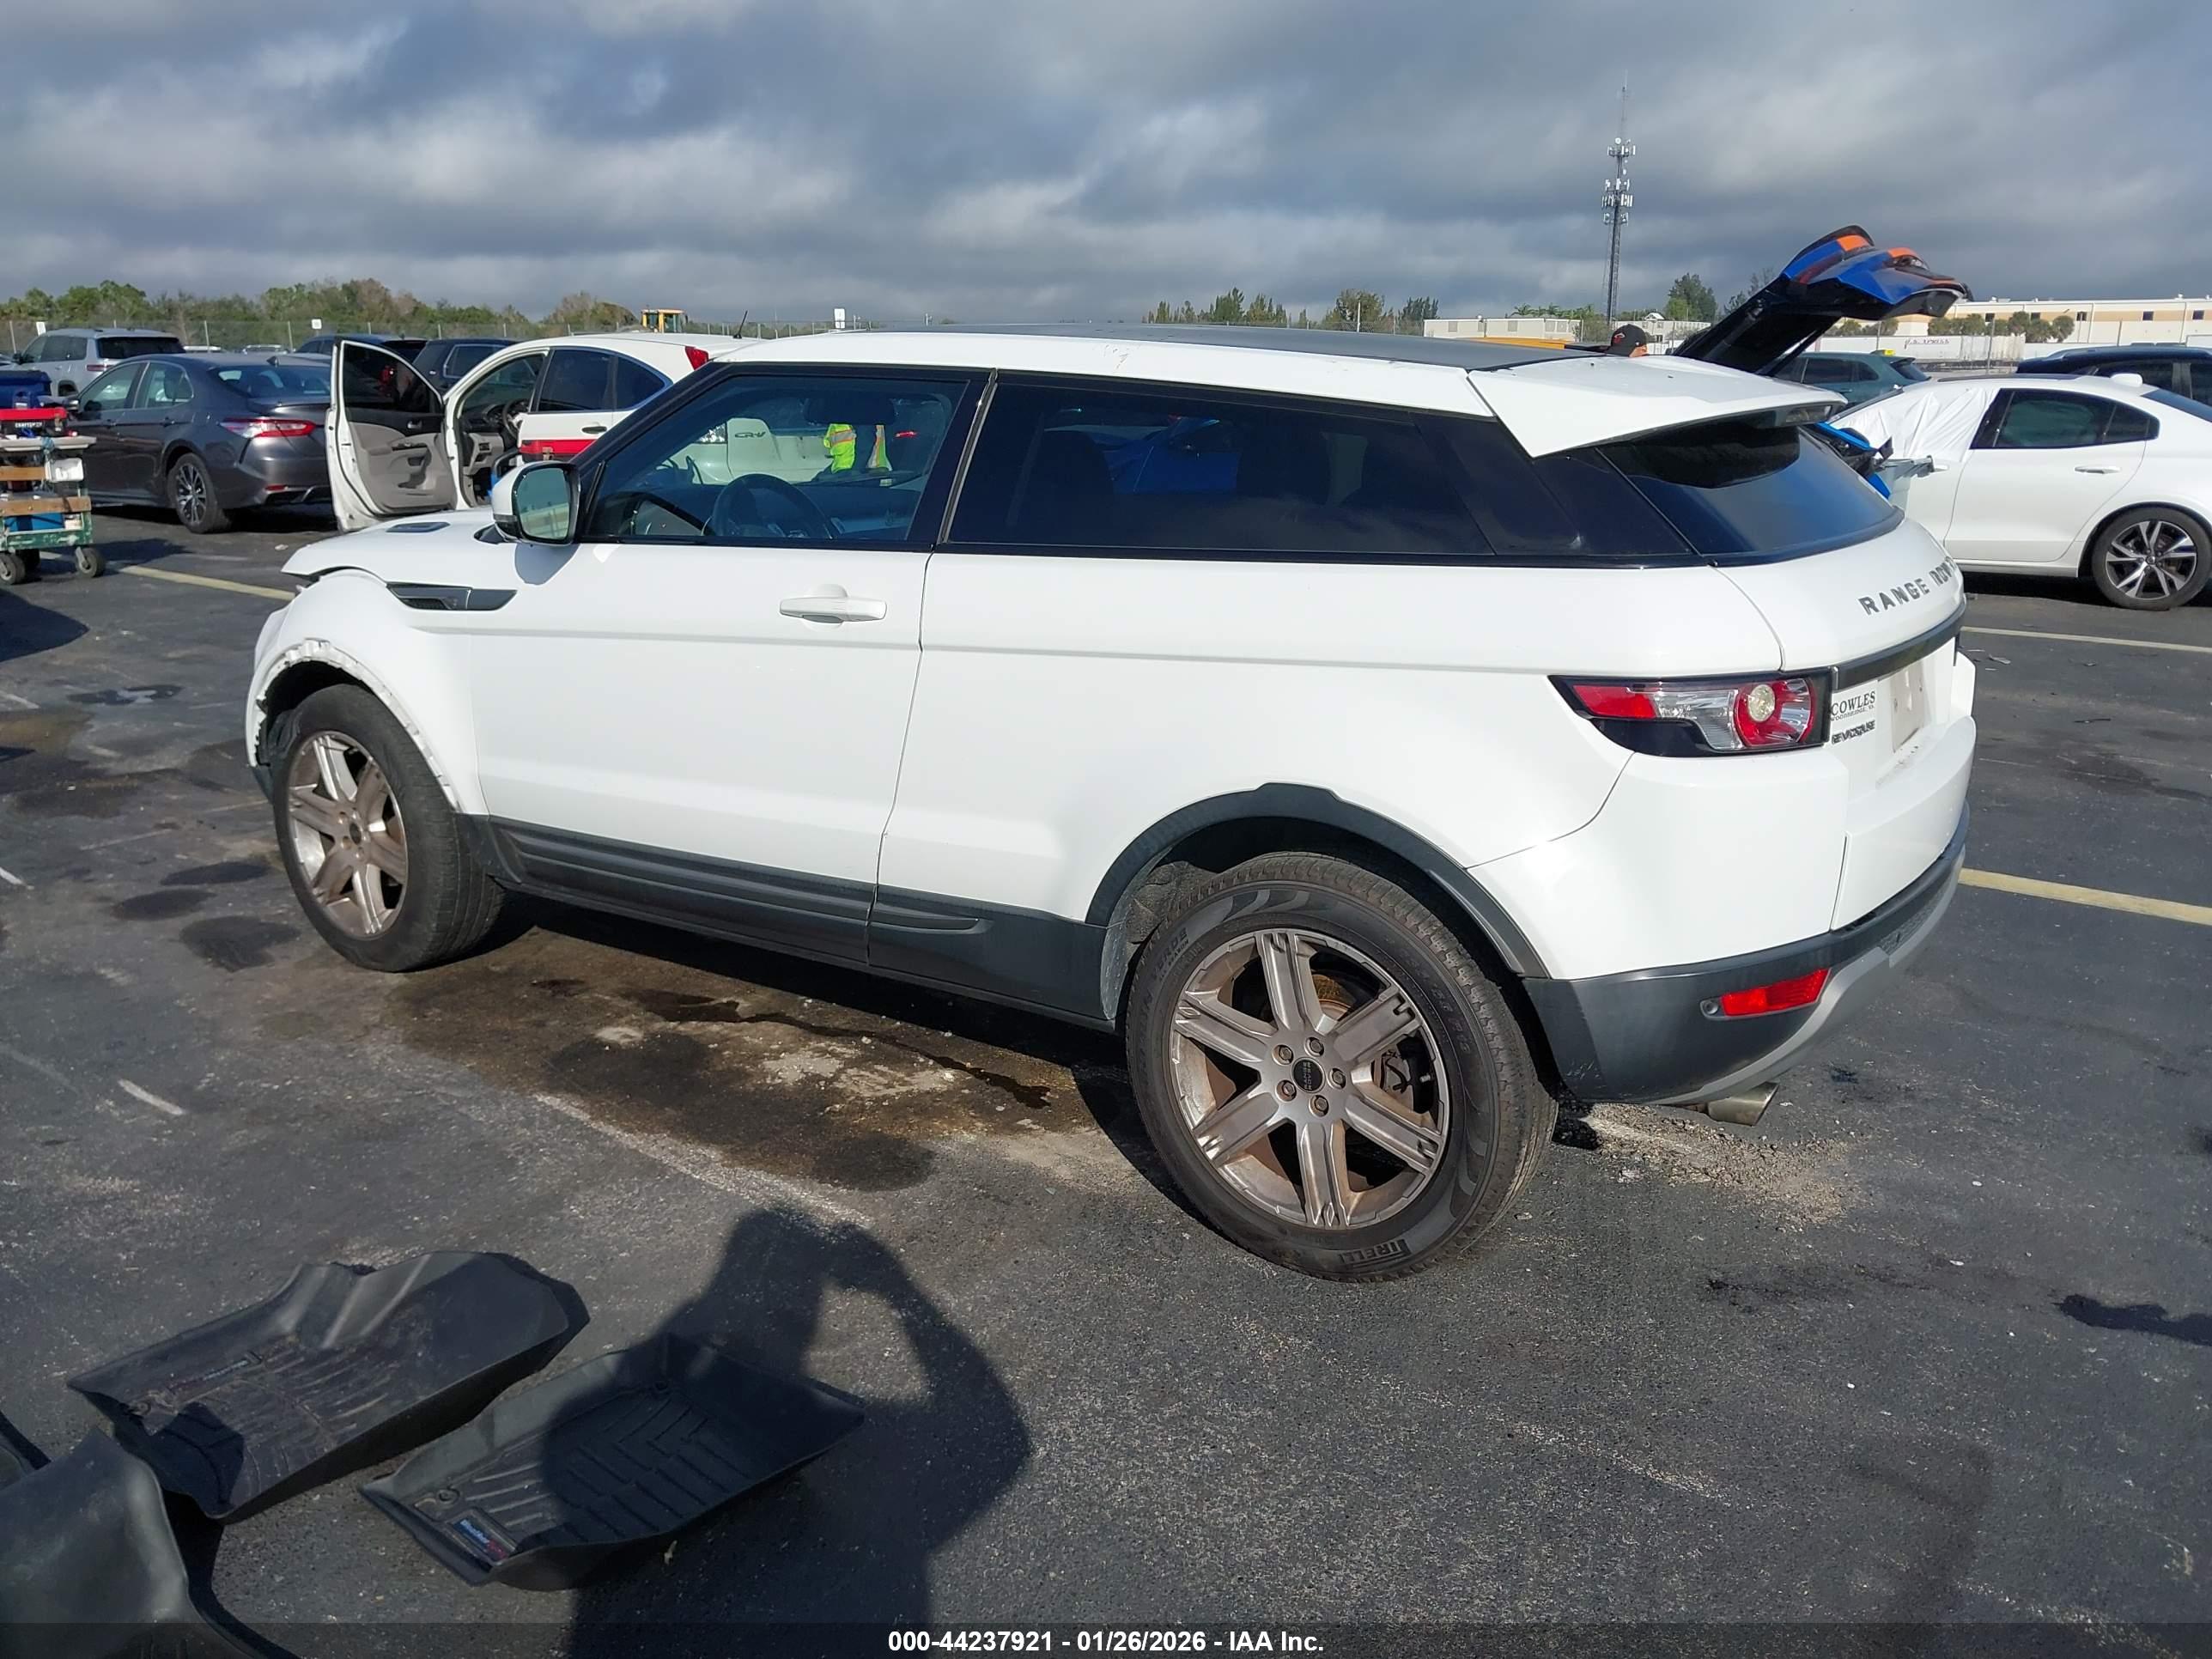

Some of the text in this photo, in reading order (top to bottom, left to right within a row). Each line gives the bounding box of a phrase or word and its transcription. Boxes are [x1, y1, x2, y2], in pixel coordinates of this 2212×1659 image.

[1858, 578, 1929, 616] RANGE
[1830, 690, 1875, 716] COWLES
[1831, 720, 1875, 745] EVOQUE
